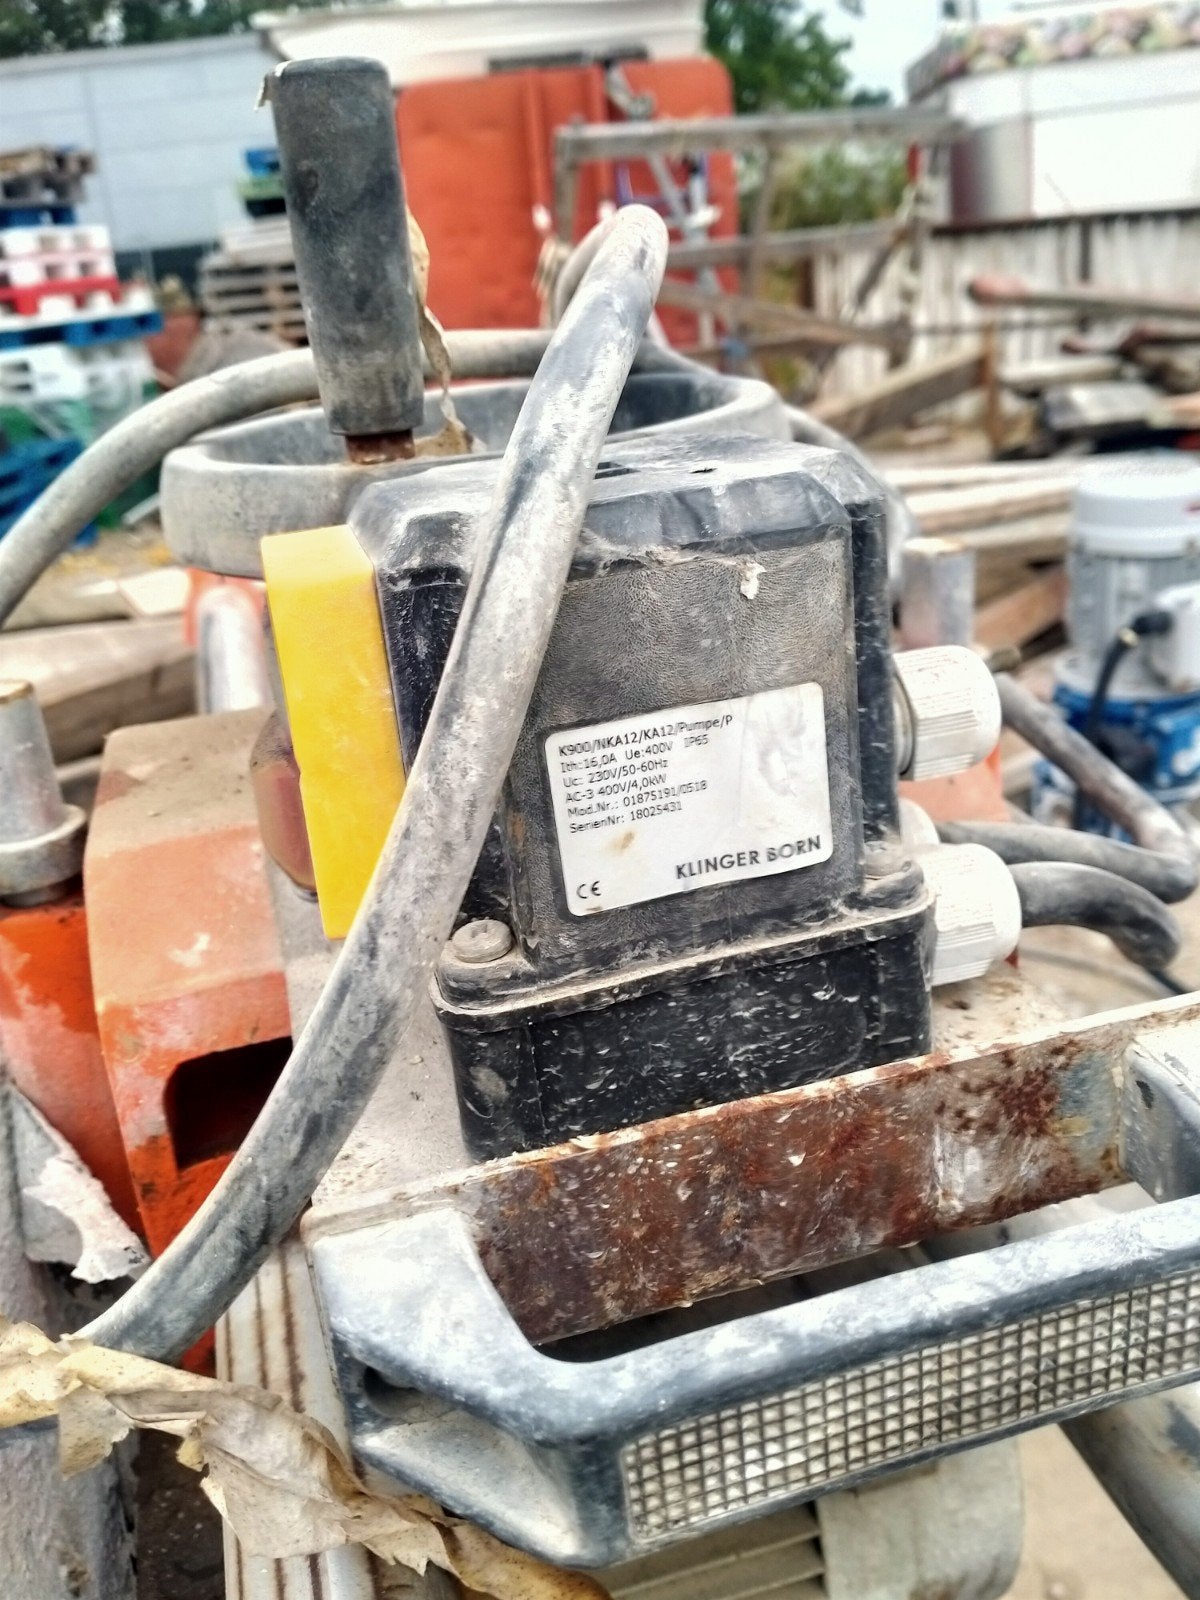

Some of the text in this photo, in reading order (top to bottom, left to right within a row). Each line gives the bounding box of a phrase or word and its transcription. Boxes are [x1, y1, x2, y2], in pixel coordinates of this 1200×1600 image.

[625, 741, 673, 760] Ue:400V
[684, 734, 709, 749] IP65
[563, 758, 669, 788] Uc: 230V/50-60Hz
[566, 774, 667, 803] AC-3 400V/4,0kW
[630, 801, 683, 821] 18025431
[675, 835, 821, 880] KLINGER BORN
